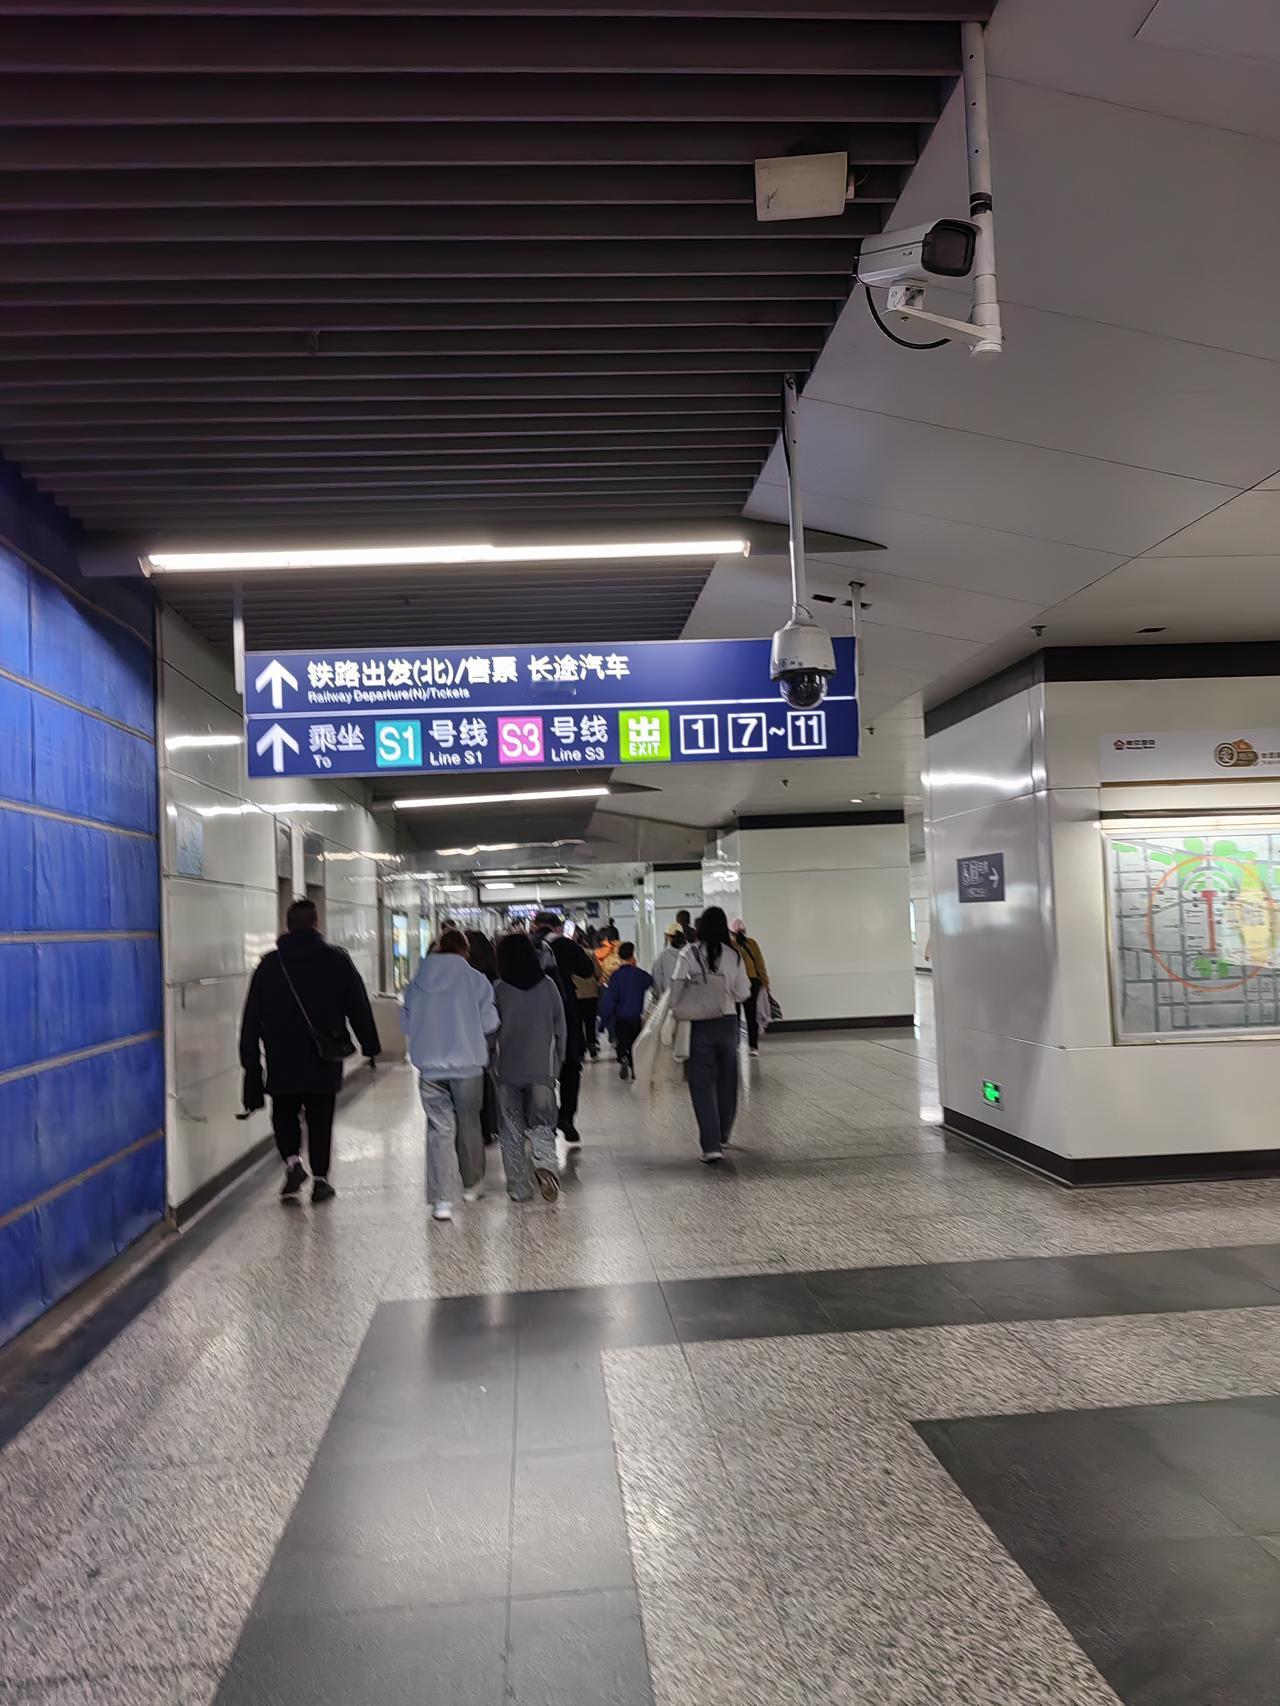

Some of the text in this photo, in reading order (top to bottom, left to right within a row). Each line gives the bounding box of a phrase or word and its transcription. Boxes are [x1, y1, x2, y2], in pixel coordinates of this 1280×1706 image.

[307, 653, 631, 689] 铁路出发(北)/售票 长途汽车
[307, 689, 352, 704] Railway
[308, 723, 366, 753] 乘坐
[379, 726, 415, 761] S1
[428, 717, 489, 748] 号线
[502, 722, 541, 758] S3
[550, 714, 609, 744] 号线
[691, 719, 705, 748] 1
[551, 747, 582, 762] Line
[629, 742, 661, 756] EXIT
[313, 754, 332, 769] To
[429, 750, 482, 766] Line S1
